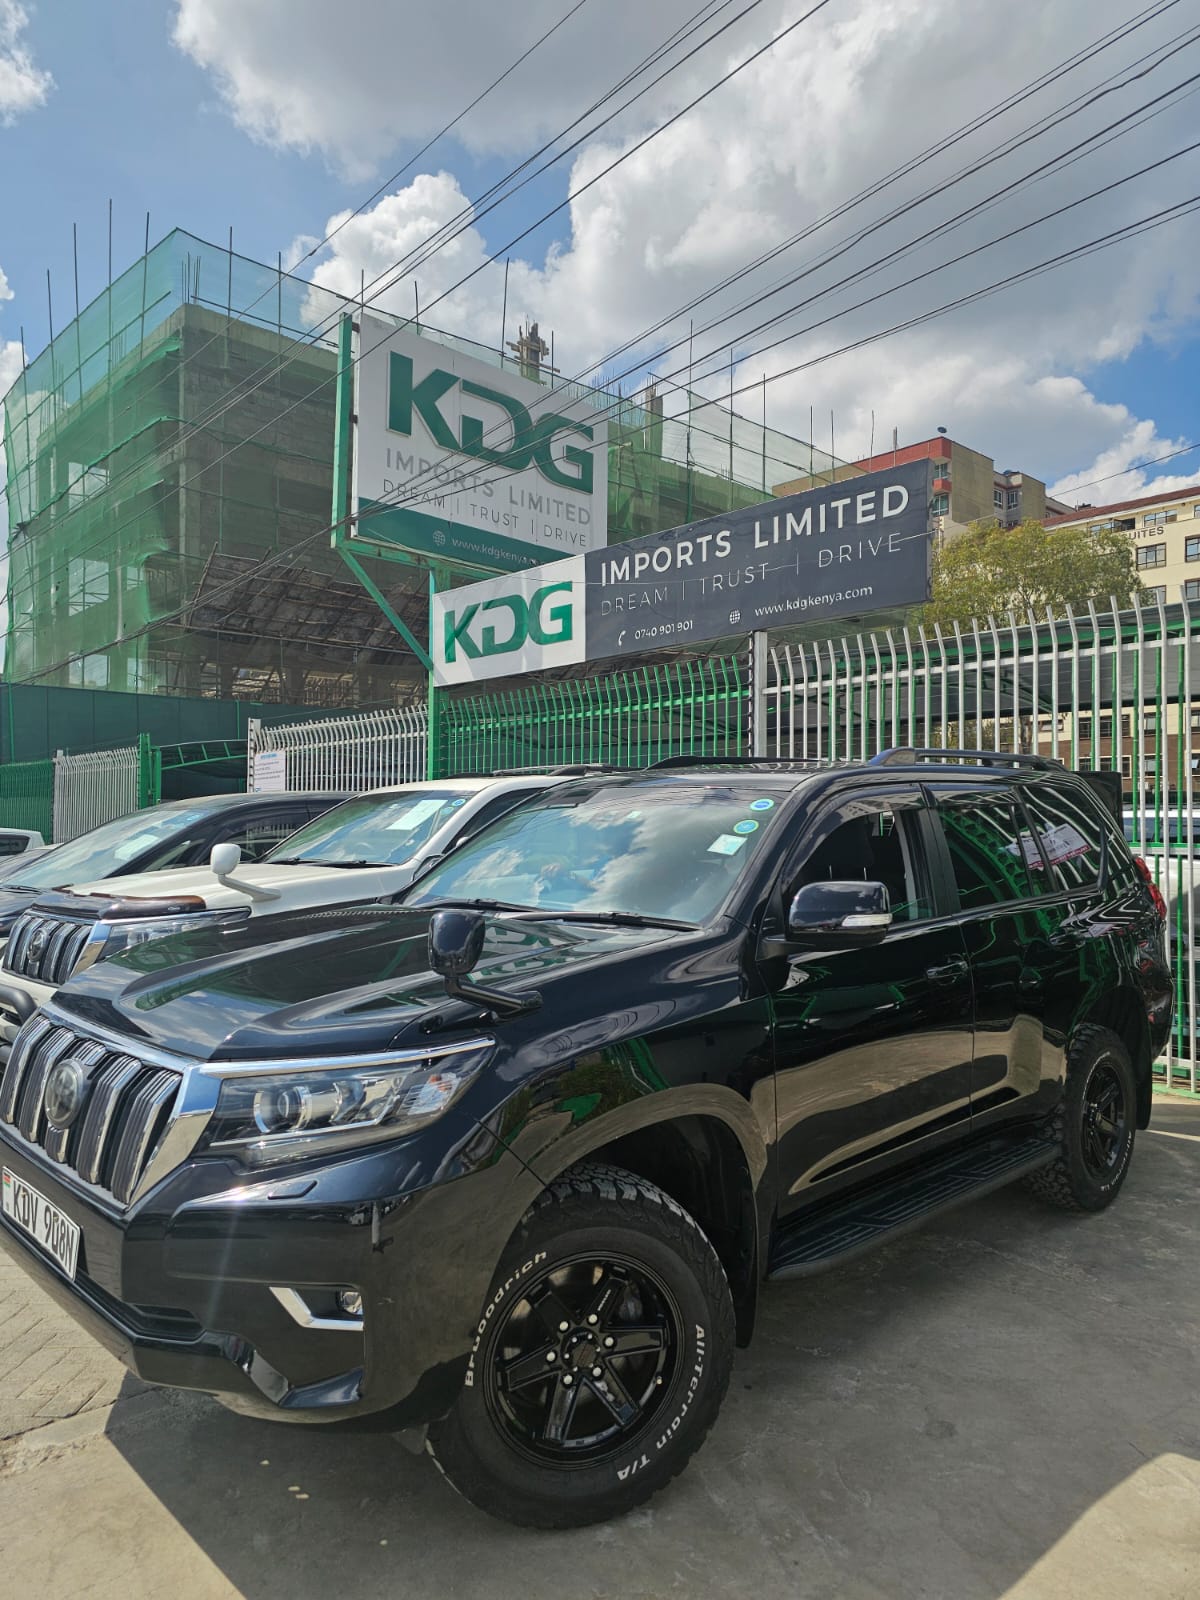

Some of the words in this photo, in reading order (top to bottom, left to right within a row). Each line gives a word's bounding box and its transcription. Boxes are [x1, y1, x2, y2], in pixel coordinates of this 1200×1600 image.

[388, 351, 593, 494] KDG
[383, 479, 445, 508] DREAM
[469, 503, 519, 529] TRUST
[543, 525, 587, 547] DRIVE
[386, 448, 494, 498] IMPORTS
[509, 485, 591, 525] LIMITED
[601, 530, 732, 587] IMPORTS
[754, 485, 909, 549] LIMITED
[1121, 526, 1164, 540] UITES
[601, 586, 668, 616] DREAM
[699, 562, 769, 596] TRUST
[818, 532, 901, 568] DRIVE
[754, 584, 873, 617] www.kdgkenya.com
[444, 581, 573, 664] KDG
[634, 627, 657, 640] 0740
[659, 623, 675, 635] 901
[676, 620, 693, 631] 901
[13, 1180, 39, 1235] KDV
[655, 1324, 705, 1449] All-Terrain
[617, 1454, 651, 1481] T/A
